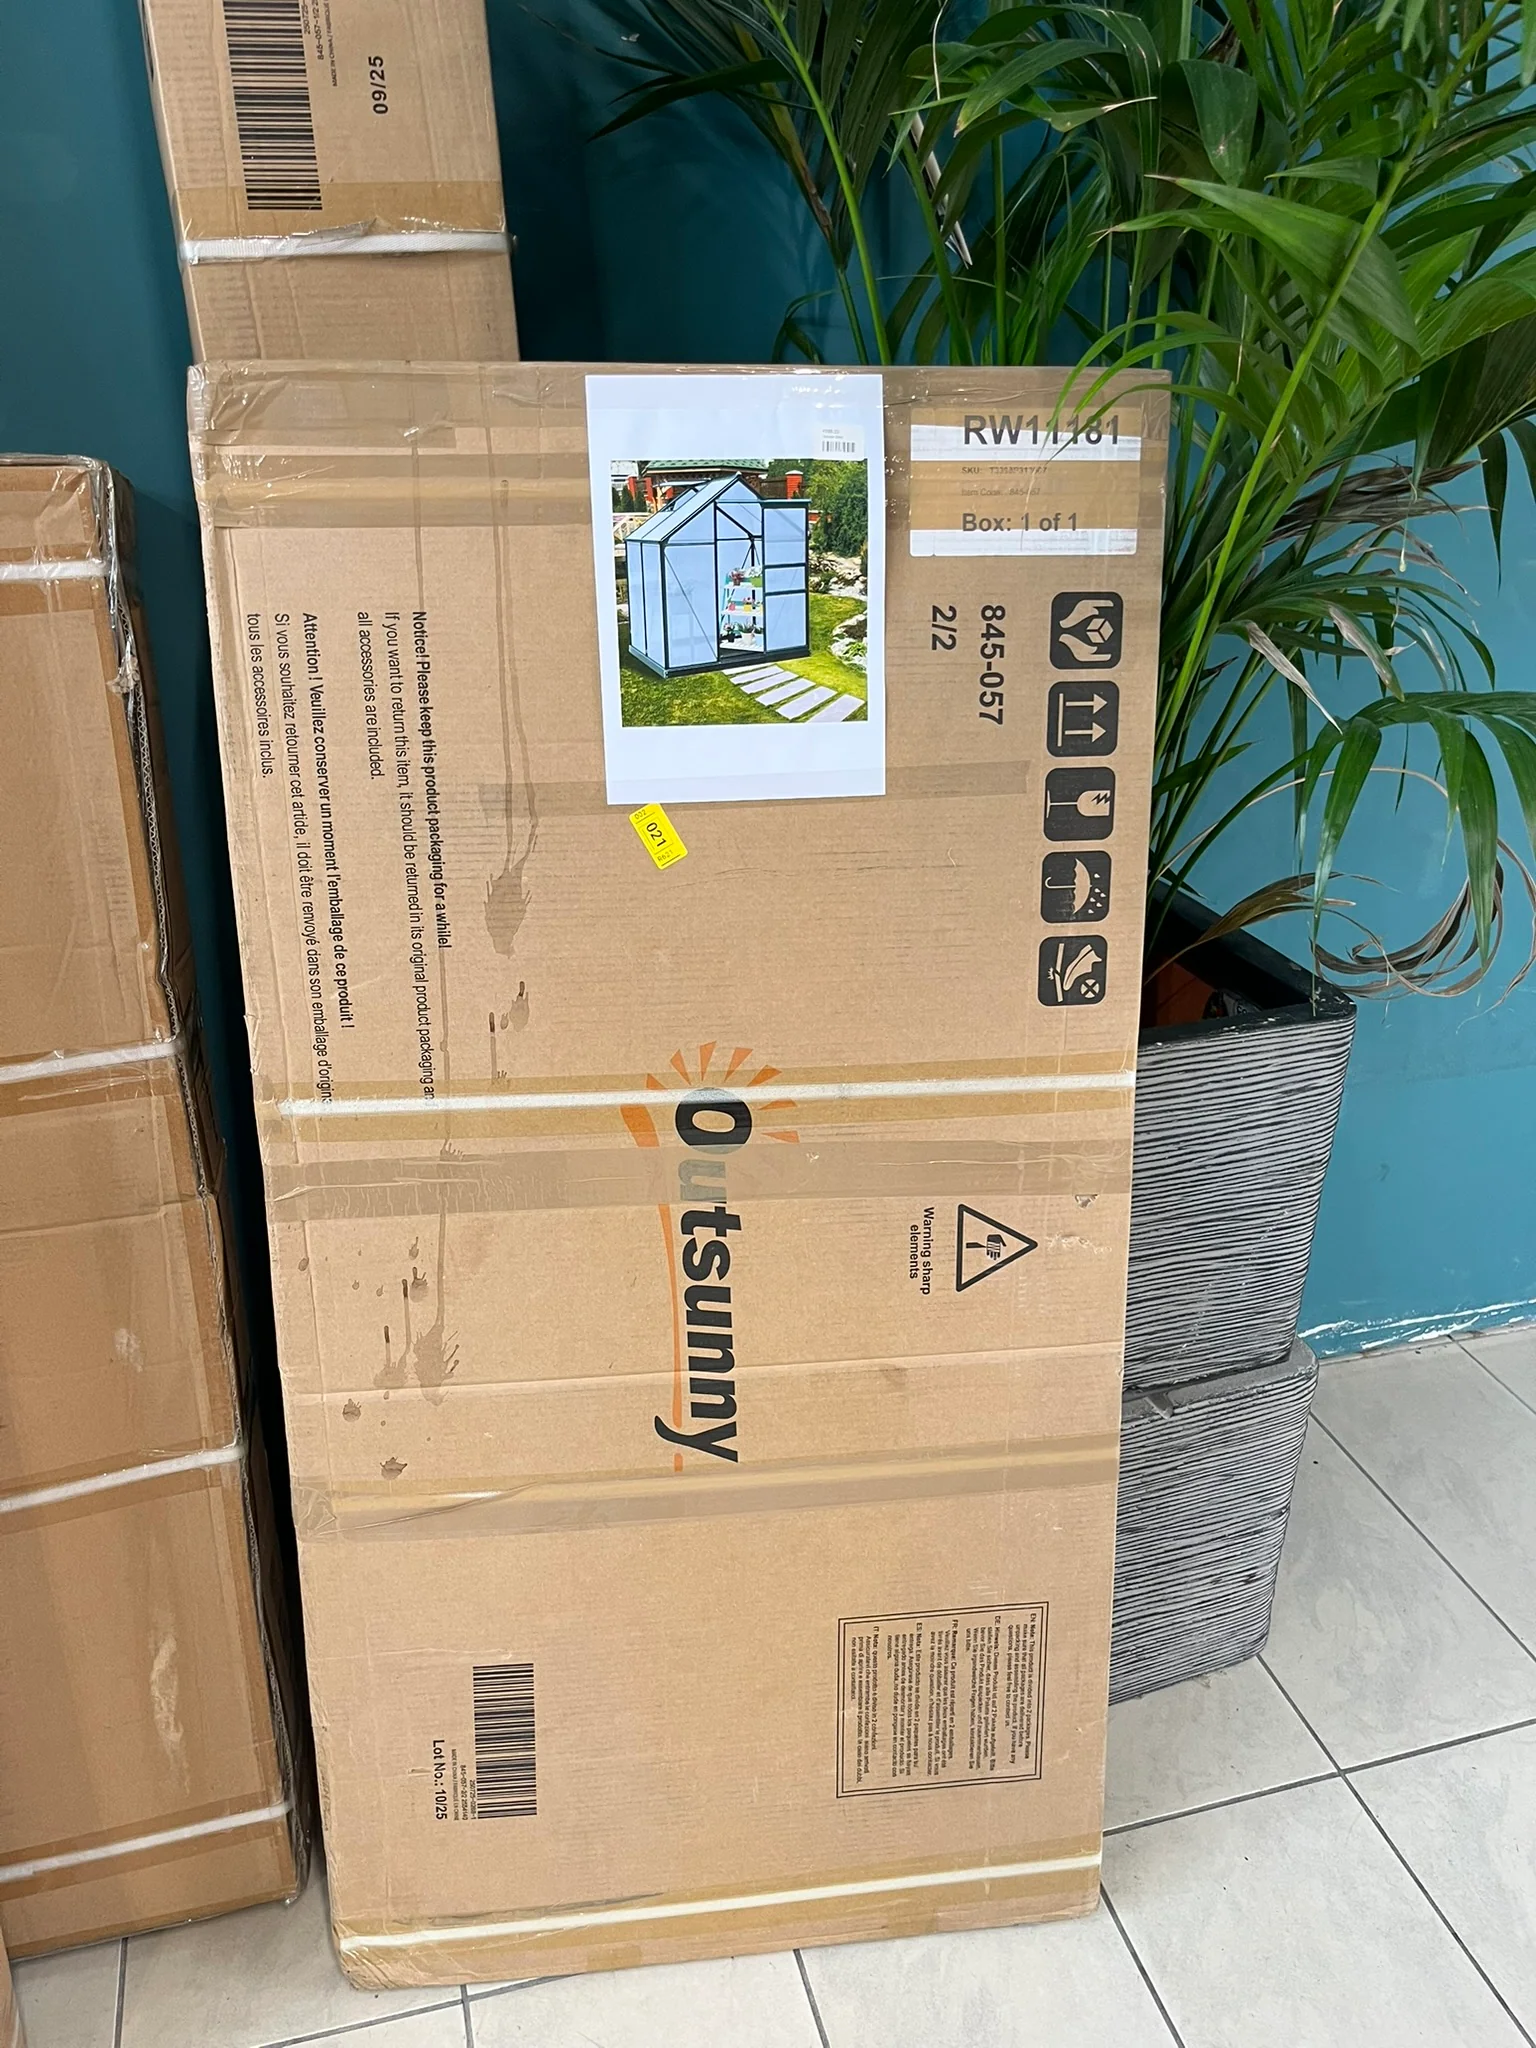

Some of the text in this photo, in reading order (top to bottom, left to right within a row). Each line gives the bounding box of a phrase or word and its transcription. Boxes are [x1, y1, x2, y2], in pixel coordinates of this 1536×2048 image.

[369, 55, 389, 115] 09/25
[964, 414, 1119, 445] RW11181
[962, 512, 1077, 532] Box: 1 of 1
[273, 613, 290, 625] Si
[381, 623, 398, 645] you
[383, 611, 399, 620] If
[931, 605, 957, 651] 2/2
[275, 629, 289, 660] vous
[302, 612, 322, 673] Attention
[411, 611, 430, 658] Notice!
[386, 649, 404, 678] want
[415, 661, 433, 703] Please
[978, 604, 1006, 726] 845-057
[246, 613, 277, 778] tous les accessoires inclus.
[278, 662, 299, 719] souhaitez
[356, 611, 385, 780] all accessories are included.
[389, 682, 405, 693] to
[308, 683, 328, 733] Veuillez
[390, 697, 408, 733] return
[415, 706, 436, 736] keep
[284, 723, 304, 777] retourner
[394, 736, 410, 756] this
[421, 739, 438, 763] this
[313, 736, 330, 801] conserver
[392, 760, 413, 787] item,
[289, 780, 306, 797] cet
[419, 766, 442, 814] product
[319, 803, 332, 817] un
[399, 802, 417, 841] should
[321, 820, 340, 870] moment
[403, 844, 418, 858] be
[424, 818, 447, 879] packaging
[646, 822, 667, 847] 021
[296, 851, 313, 872] doit
[299, 875, 316, 897] être
[404, 862, 423, 910] returned
[432, 883, 449, 900] for
[298, 901, 320, 945] renvoyé
[323, 874, 347, 941] l'emballage
[408, 912, 424, 922] in
[409, 926, 425, 939] its
[435, 912, 452, 948] while!
[306, 949, 323, 975] dans
[333, 944, 348, 959] de
[334, 963, 346, 976] ce
[408, 942, 429, 982] original
[309, 978, 322, 998] son
[332, 978, 354, 1021] produit
[411, 985, 432, 1026] product
[308, 1002, 331, 1056] emballage
[415, 1029, 437, 1083] packaging
[423, 1086, 435, 1100] an
[909, 1224, 921, 1279] elements
[920, 1206, 935, 1295] Warning sharp
[654, 1087, 753, 1463] Outsunny
[432, 1739, 447, 1819] Lot No.: 10/25
